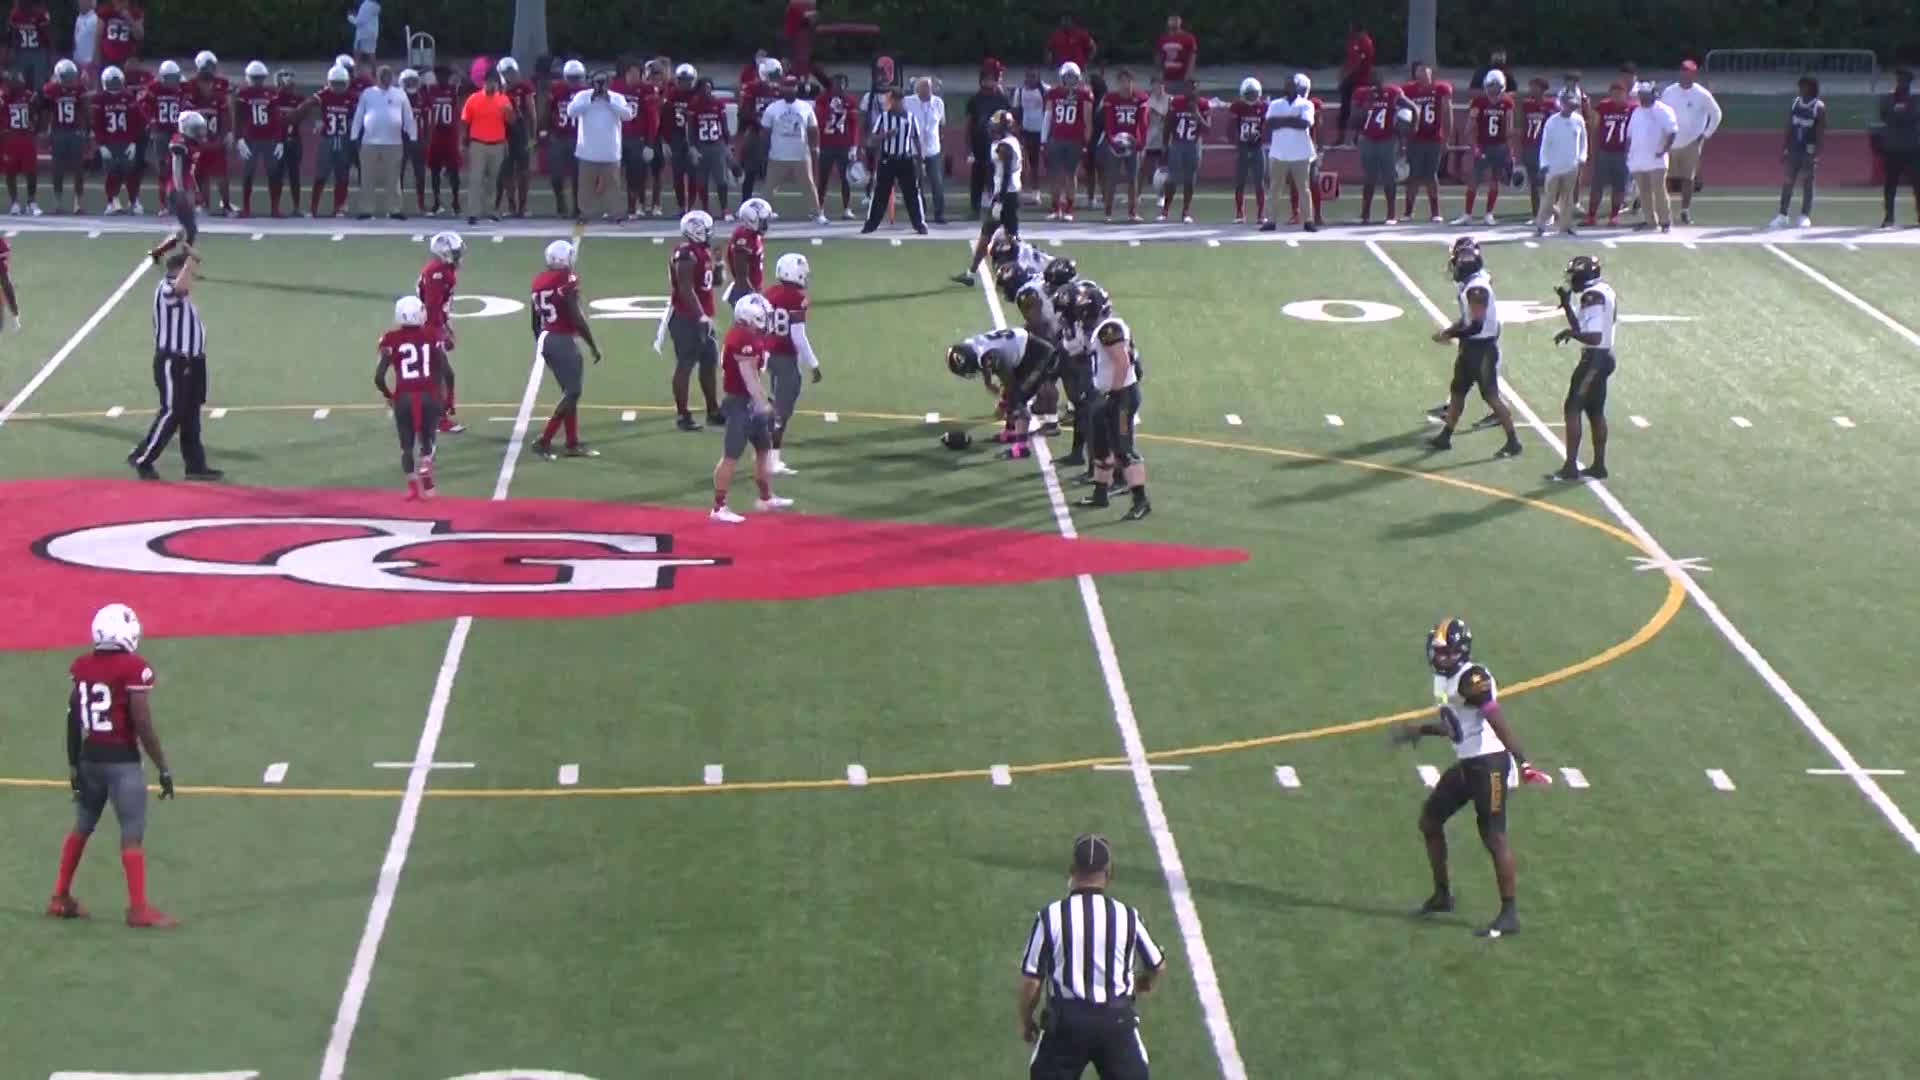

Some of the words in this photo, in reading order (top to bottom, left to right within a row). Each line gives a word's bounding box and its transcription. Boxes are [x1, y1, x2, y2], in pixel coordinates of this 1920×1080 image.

[57, 102, 75, 123] 19
[105, 112, 127, 133] 34
[251, 104, 268, 125] 16
[432, 103, 452, 124] 70
[1056, 105, 1076, 124] 90
[326, 113, 347, 135] 33
[699, 120, 718, 141] 22
[1176, 118, 1197, 140] 42
[1488, 116, 1499, 136] 6
[1605, 121, 1626, 143] 71
[398, 343, 430, 379] 21
[30, 517, 733, 592] CG
[78, 681, 113, 731] 12
